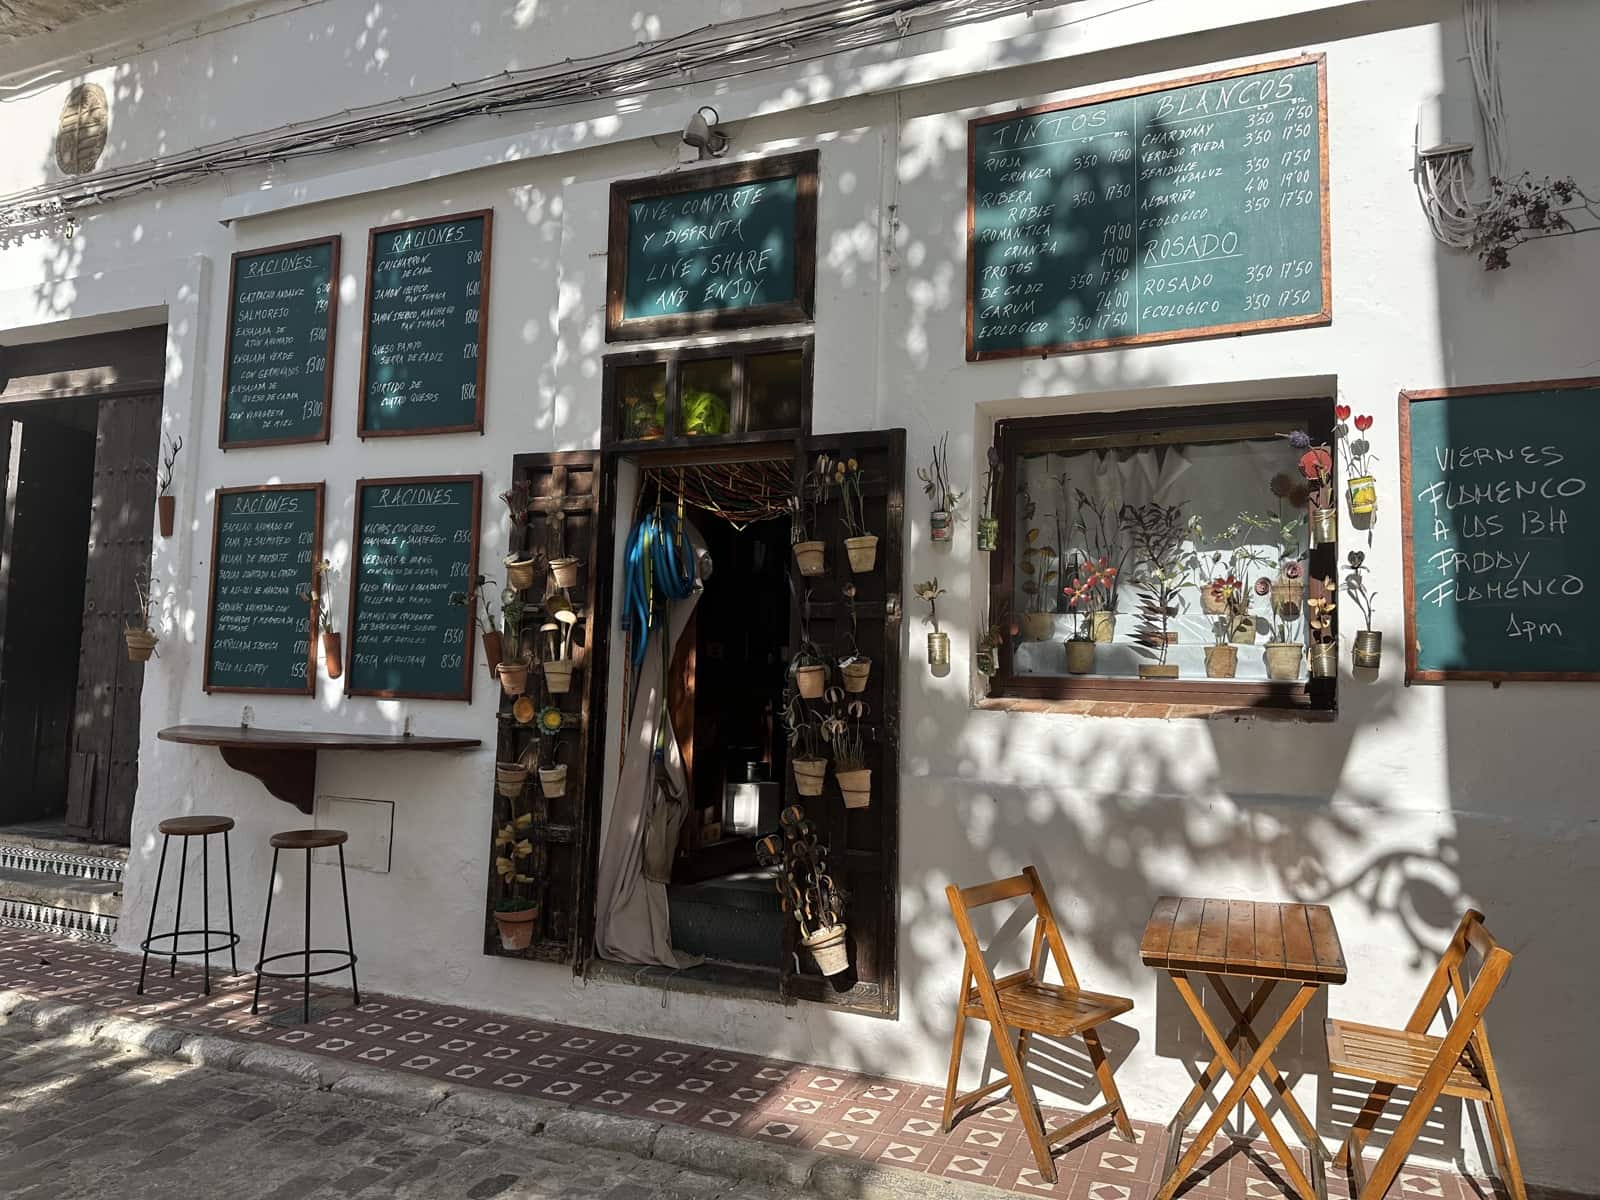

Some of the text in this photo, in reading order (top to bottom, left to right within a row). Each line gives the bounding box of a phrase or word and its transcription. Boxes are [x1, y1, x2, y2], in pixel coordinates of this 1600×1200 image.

[1150, 74, 1295, 121] BLANCOS
[1244, 111, 1273, 128] 3'50
[1284, 104, 1313, 121] 17'50
[1191, 139, 1224, 157] RUEDA
[1243, 130, 1271, 147] 3'50
[1282, 124, 1311, 140] 17'50
[984, 157, 1022, 171] RIOJA
[1074, 155, 1098, 171] 3'50
[1000, 168, 1051, 183] CRIANZA
[1140, 149, 1310, 180] SEMIDULCE 3'50 17'50
[1173, 167, 1224, 186] ANDALUZ
[1245, 175, 1268, 193] 4'00
[1280, 170, 1310, 186] 19'00
[682, 187, 767, 216] COMPARTE
[981, 184, 1131, 208] RIBERA 3'50 17'50
[1008, 204, 1056, 222] ROBLE
[1139, 190, 1313, 230] ECOLOGICO 3'50 17'50
[392, 226, 465, 252] RACIONES
[643, 219, 745, 250] Y DISFRUTA
[982, 222, 1131, 244] ROMANTICA 19'00
[1004, 242, 1057, 258] CRIANZA
[1144, 232, 1238, 264] ROSADO
[248, 255, 312, 277] RACIONES
[711, 248, 773, 277] SHARE
[982, 246, 1129, 280] PROTOS 19'00
[981, 287, 999, 300] DE
[1069, 273, 1092, 289] 3'50
[1100, 268, 1129, 285] 17'50
[1144, 260, 1313, 296] ROSADO 3'50 17'50
[656, 278, 764, 310] AND ENJOY
[980, 288, 1129, 319] GARUM 24'00
[1142, 289, 1311, 319] ECOLOGICO 3'50 17'50
[239, 308, 289, 322] SALMOREJO
[978, 311, 1128, 339] ECOLOGICO 3'50 17'50
[372, 344, 393, 355] QUESO
[371, 381, 405, 394] SURTIDO
[1436, 445, 1564, 472] VIERNES
[234, 496, 299, 512] RACIONES
[380, 488, 452, 508] RACIONES
[1418, 478, 1586, 516] FLAMENCO
[1432, 519, 1449, 541] A
[1422, 574, 1584, 608] FLAMENCO
[1506, 613, 1562, 642] 1pm
